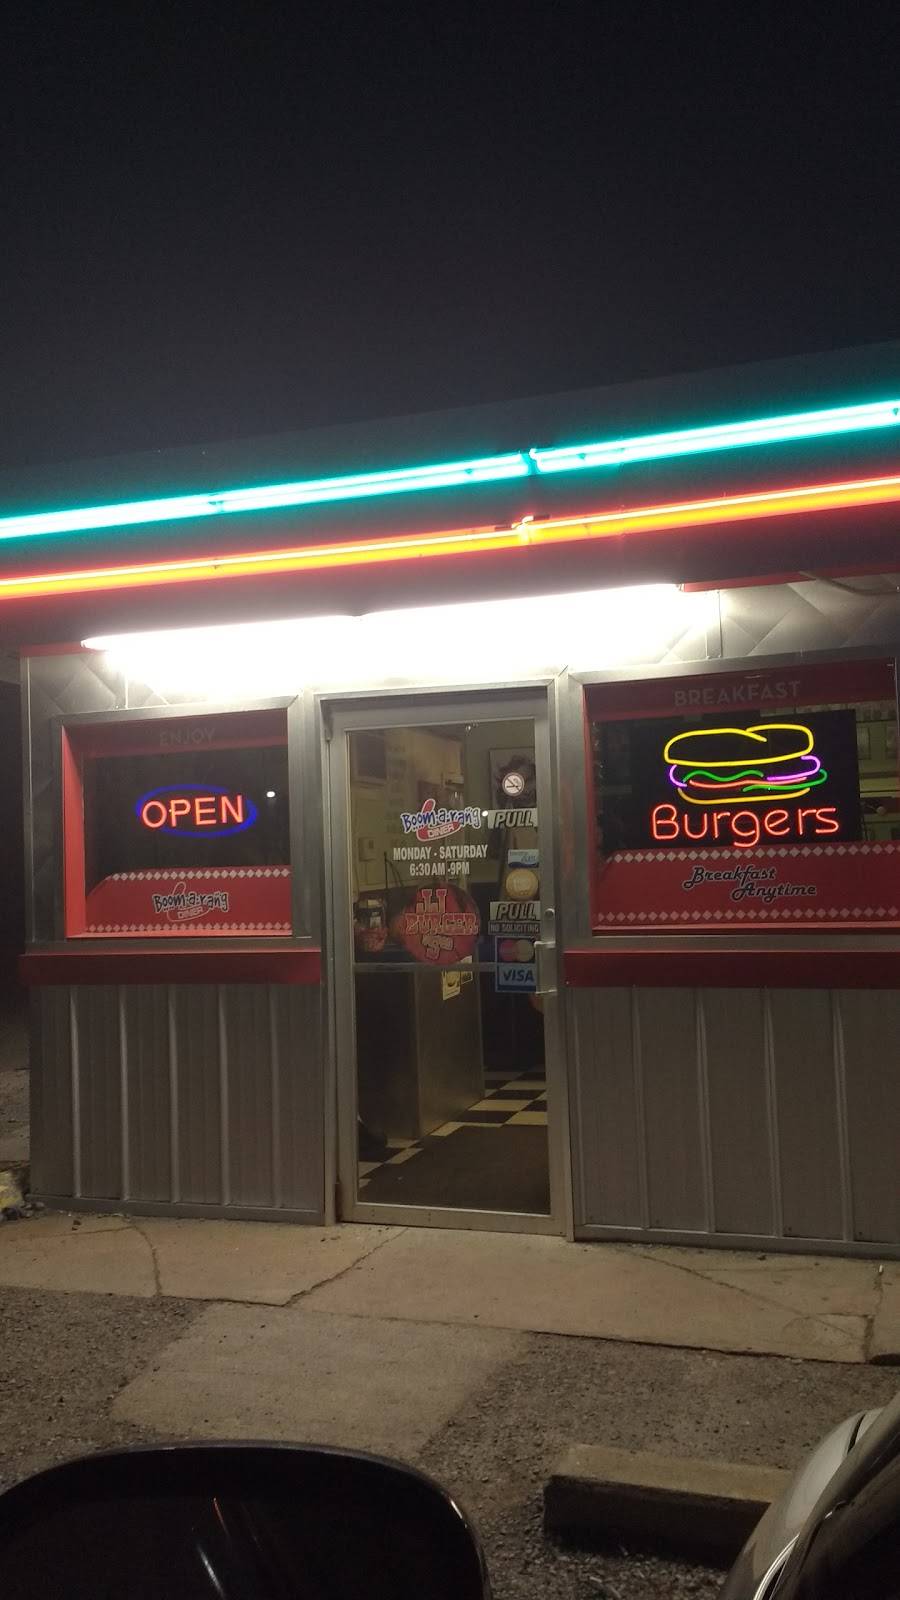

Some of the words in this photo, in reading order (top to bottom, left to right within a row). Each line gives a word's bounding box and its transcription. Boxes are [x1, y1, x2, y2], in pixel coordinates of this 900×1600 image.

[674, 681, 801, 707] BREAKFAST
[159, 727, 215, 747] ENJOY
[141, 794, 244, 829] OPEN
[494, 810, 534, 829] PULL
[427, 823, 455, 838] DINER
[652, 803, 840, 848] Burgers
[393, 846, 432, 861] MONDAY
[439, 844, 489, 859] SATURDAY
[683, 865, 777, 889] Breakfast
[416, 888, 448, 914] JJ
[731, 881, 817, 903] Anytime
[497, 902, 536, 921] PULL
[405, 912, 479, 936] BURGER
[490, 922, 498, 933] NO
[501, 921, 540, 934] SOLICITING
[502, 969, 535, 982] VISA
